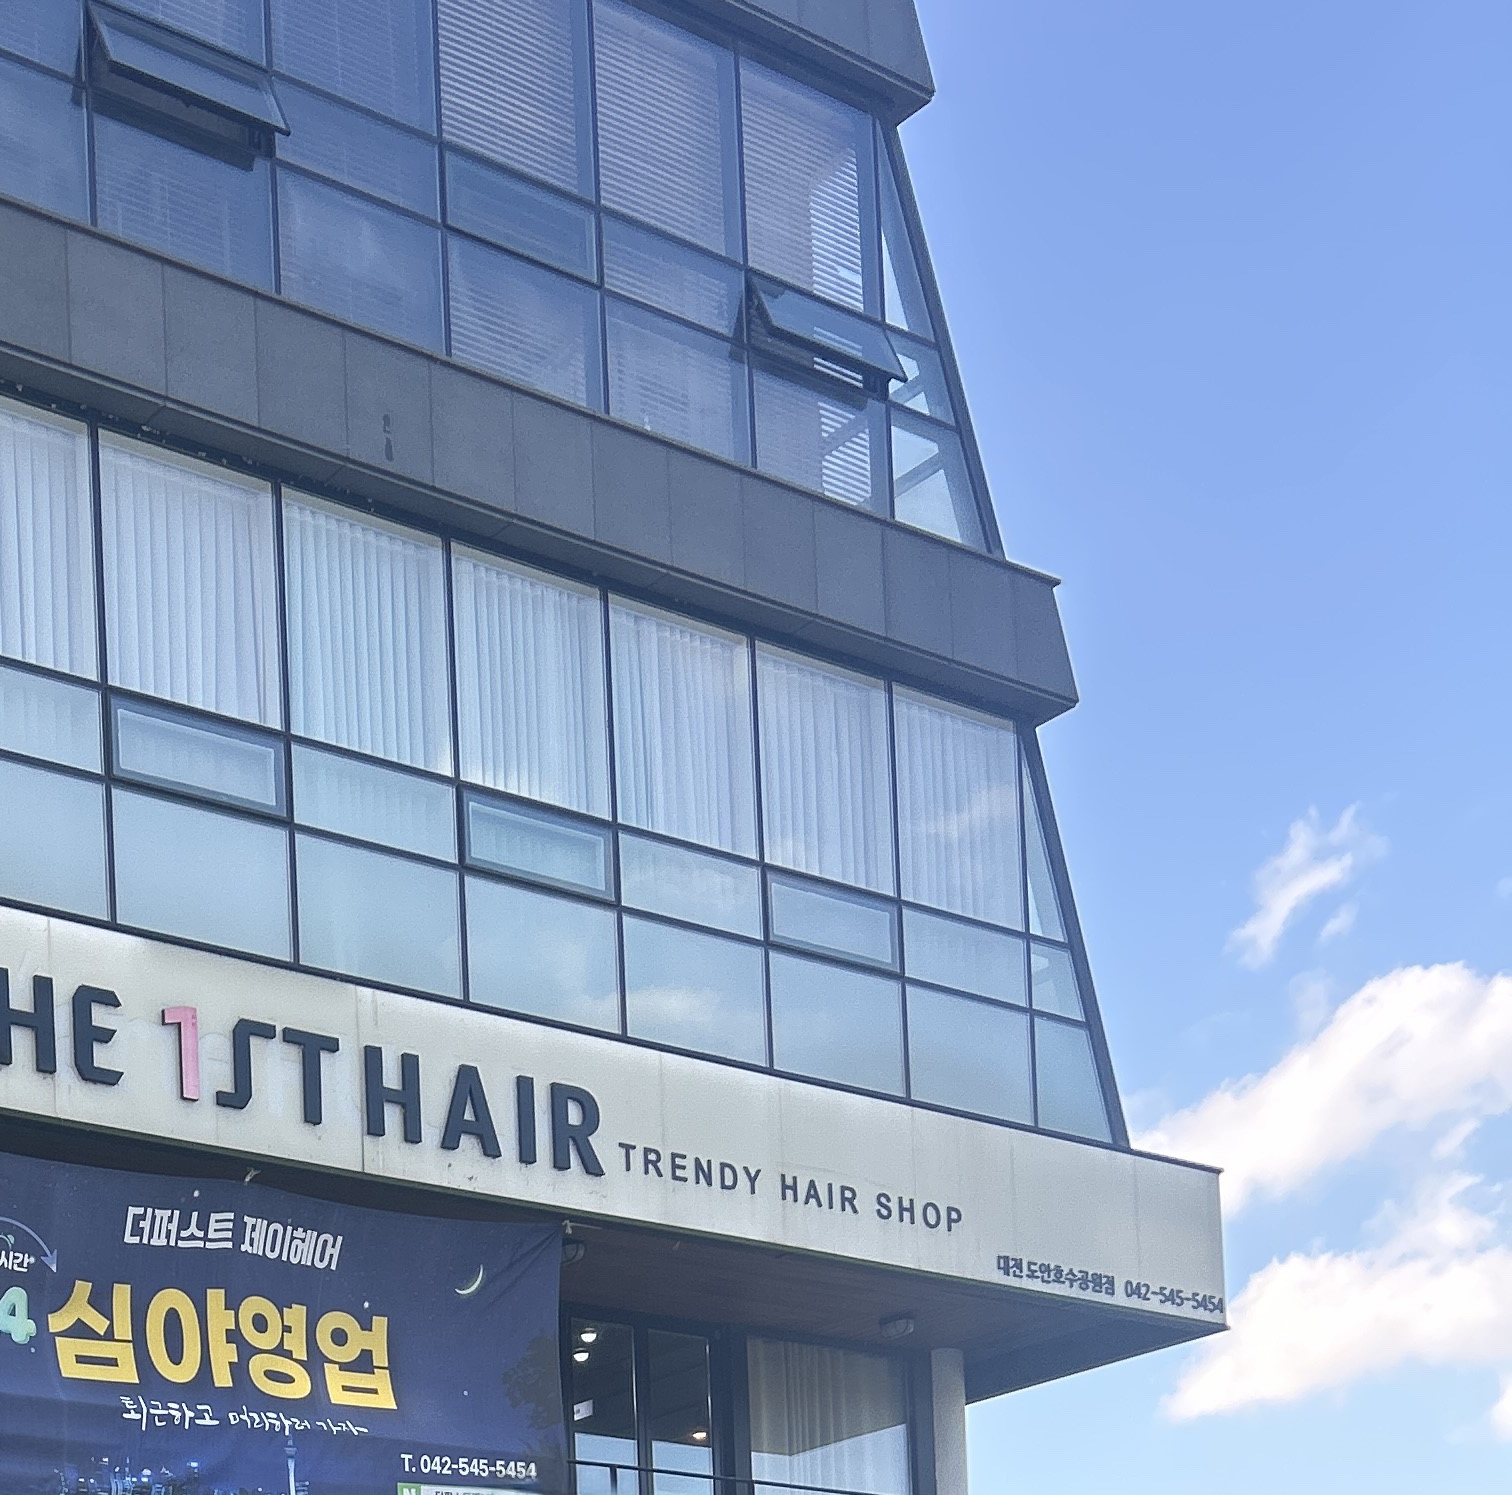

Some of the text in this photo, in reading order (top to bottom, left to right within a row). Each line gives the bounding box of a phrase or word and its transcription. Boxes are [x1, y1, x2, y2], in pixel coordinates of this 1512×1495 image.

[618, 1142, 963, 1232] TRENDY HAIR SHOP
[123, 1205, 344, 1271] 더퍼스트 제이헤어
[1124, 1279, 1224, 1314] 042-545-5454
[47, 1280, 397, 1410] 심야영업
[119, 1395, 220, 1431] 퇴근하고
[228, 1405, 311, 1436] 머리하러
[400, 1453, 537, 1480] T. 042-545-5454
